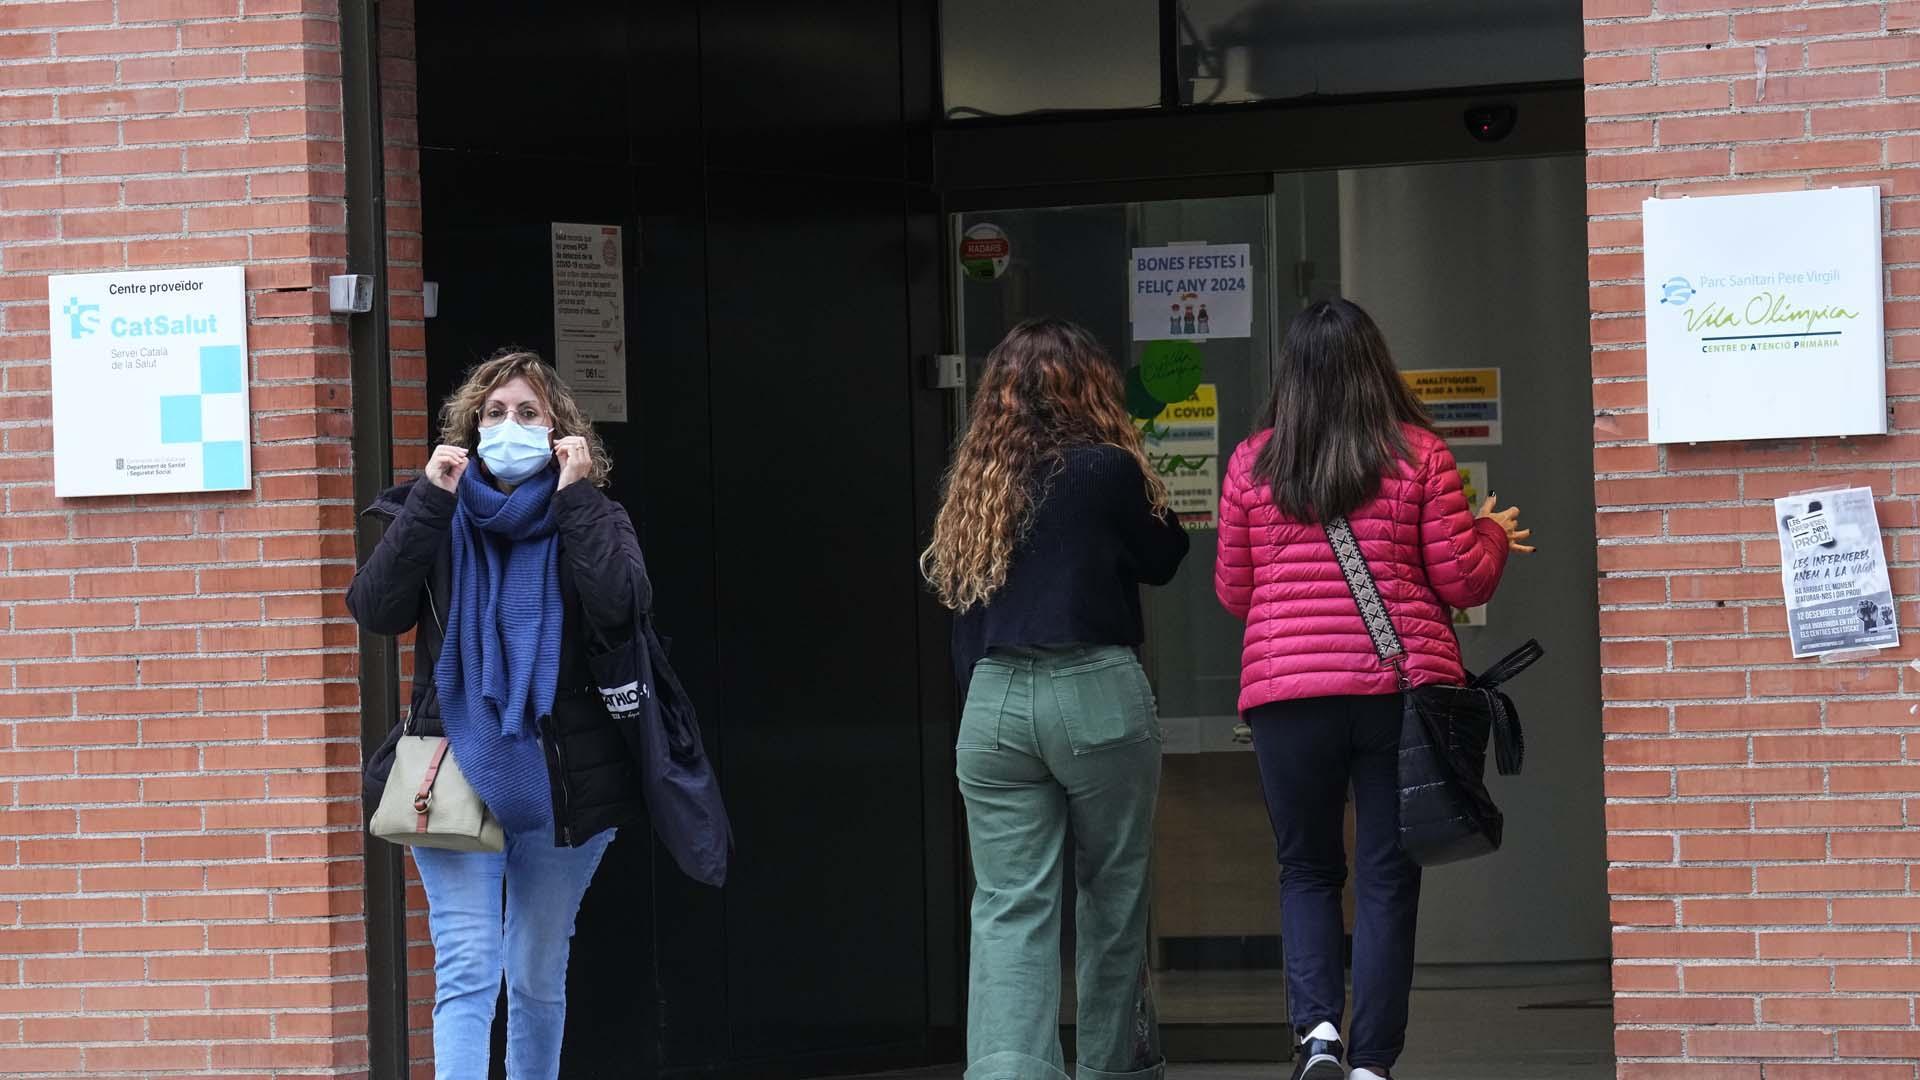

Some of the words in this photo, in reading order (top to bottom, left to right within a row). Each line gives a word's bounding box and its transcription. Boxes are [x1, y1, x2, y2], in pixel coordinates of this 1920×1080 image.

[1137, 255, 1185, 271] BONES
[1188, 254, 1236, 270] FESTES
[1240, 254, 1245, 268] I
[1700, 274, 1726, 288] Parc
[1729, 272, 1776, 288] Sanitari
[1778, 271, 1804, 286] Pere
[1806, 269, 1840, 285] Virgili
[109, 283, 146, 295] Centre
[149, 280, 204, 295] proveïdor
[1137, 279, 1175, 297] FELIÇ
[1177, 278, 1207, 294] ANY
[1210, 277, 1246, 292] 2024
[1684, 301, 1742, 332] Vila
[110, 314, 217, 337] CatSalut
[111, 348, 138, 358] Servei
[140, 346, 169, 358] Català
[1702, 343, 1737, 353] CENTRE
[111, 360, 123, 370] de
[125, 359, 133, 369] la
[135, 358, 157, 369] Salut
[585, 368, 598, 379] 061
[1174, 407, 1215, 419] COVID
[1793, 556, 1809, 570] LES
[1812, 549, 1870, 566] INFERMERES
[1793, 569, 1820, 582] ANEM
[1824, 567, 1830, 578] A
[1835, 565, 1846, 577] LA
[1825, 583, 1832, 592] EL
[1832, 580, 1855, 590] MOMENT
[1805, 608, 1837, 620] DESEMBRE
[603, 689, 641, 708] ATHLO
